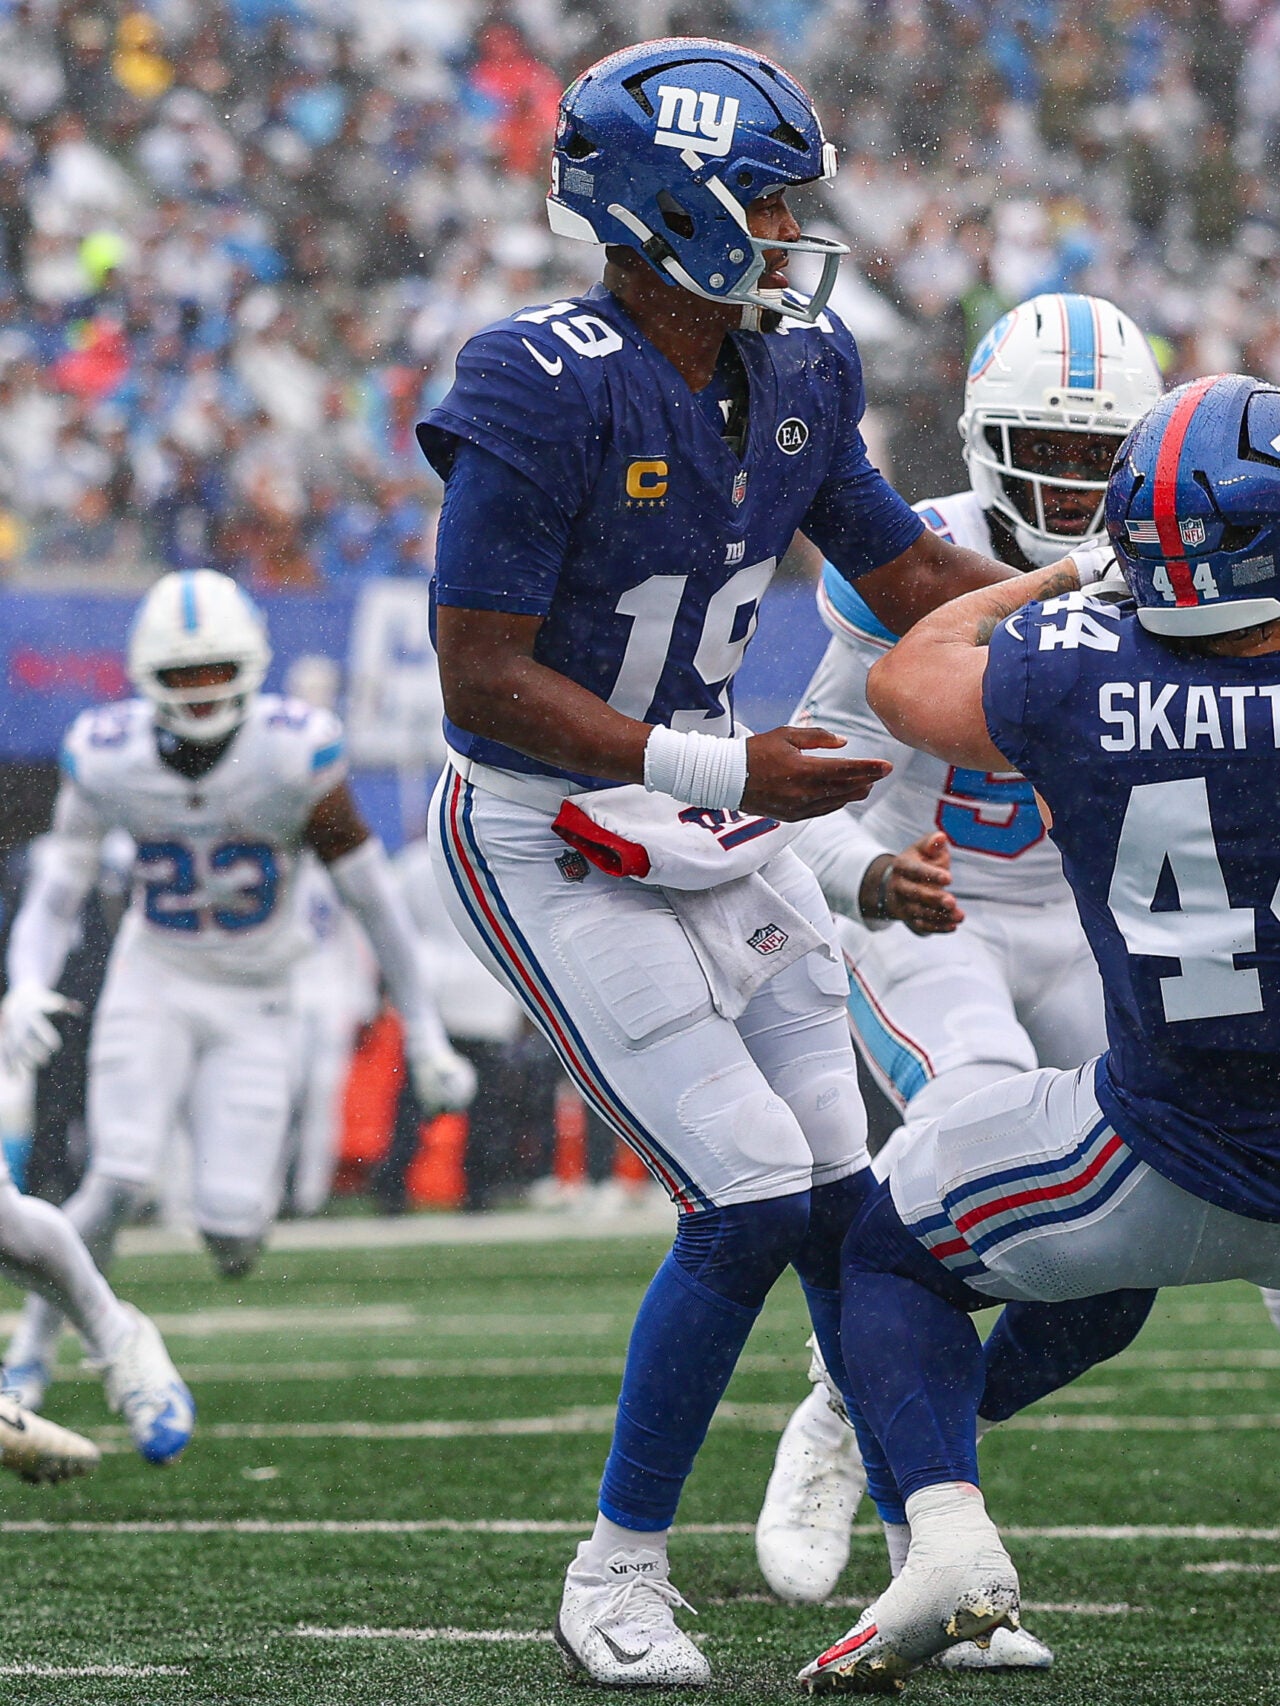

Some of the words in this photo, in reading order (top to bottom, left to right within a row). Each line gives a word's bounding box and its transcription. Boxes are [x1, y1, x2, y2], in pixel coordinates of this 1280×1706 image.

[654, 85, 740, 156] ny
[514, 302, 623, 358] 19
[782, 426, 802, 446] EA
[626, 461, 669, 499] C
[1183, 529, 1203, 541] NFL
[1153, 563, 1219, 600] 44
[1038, 591, 1121, 652] 44
[607, 556, 776, 738] 19
[135, 839, 280, 932] 23
[758, 933, 785, 953] NFL
